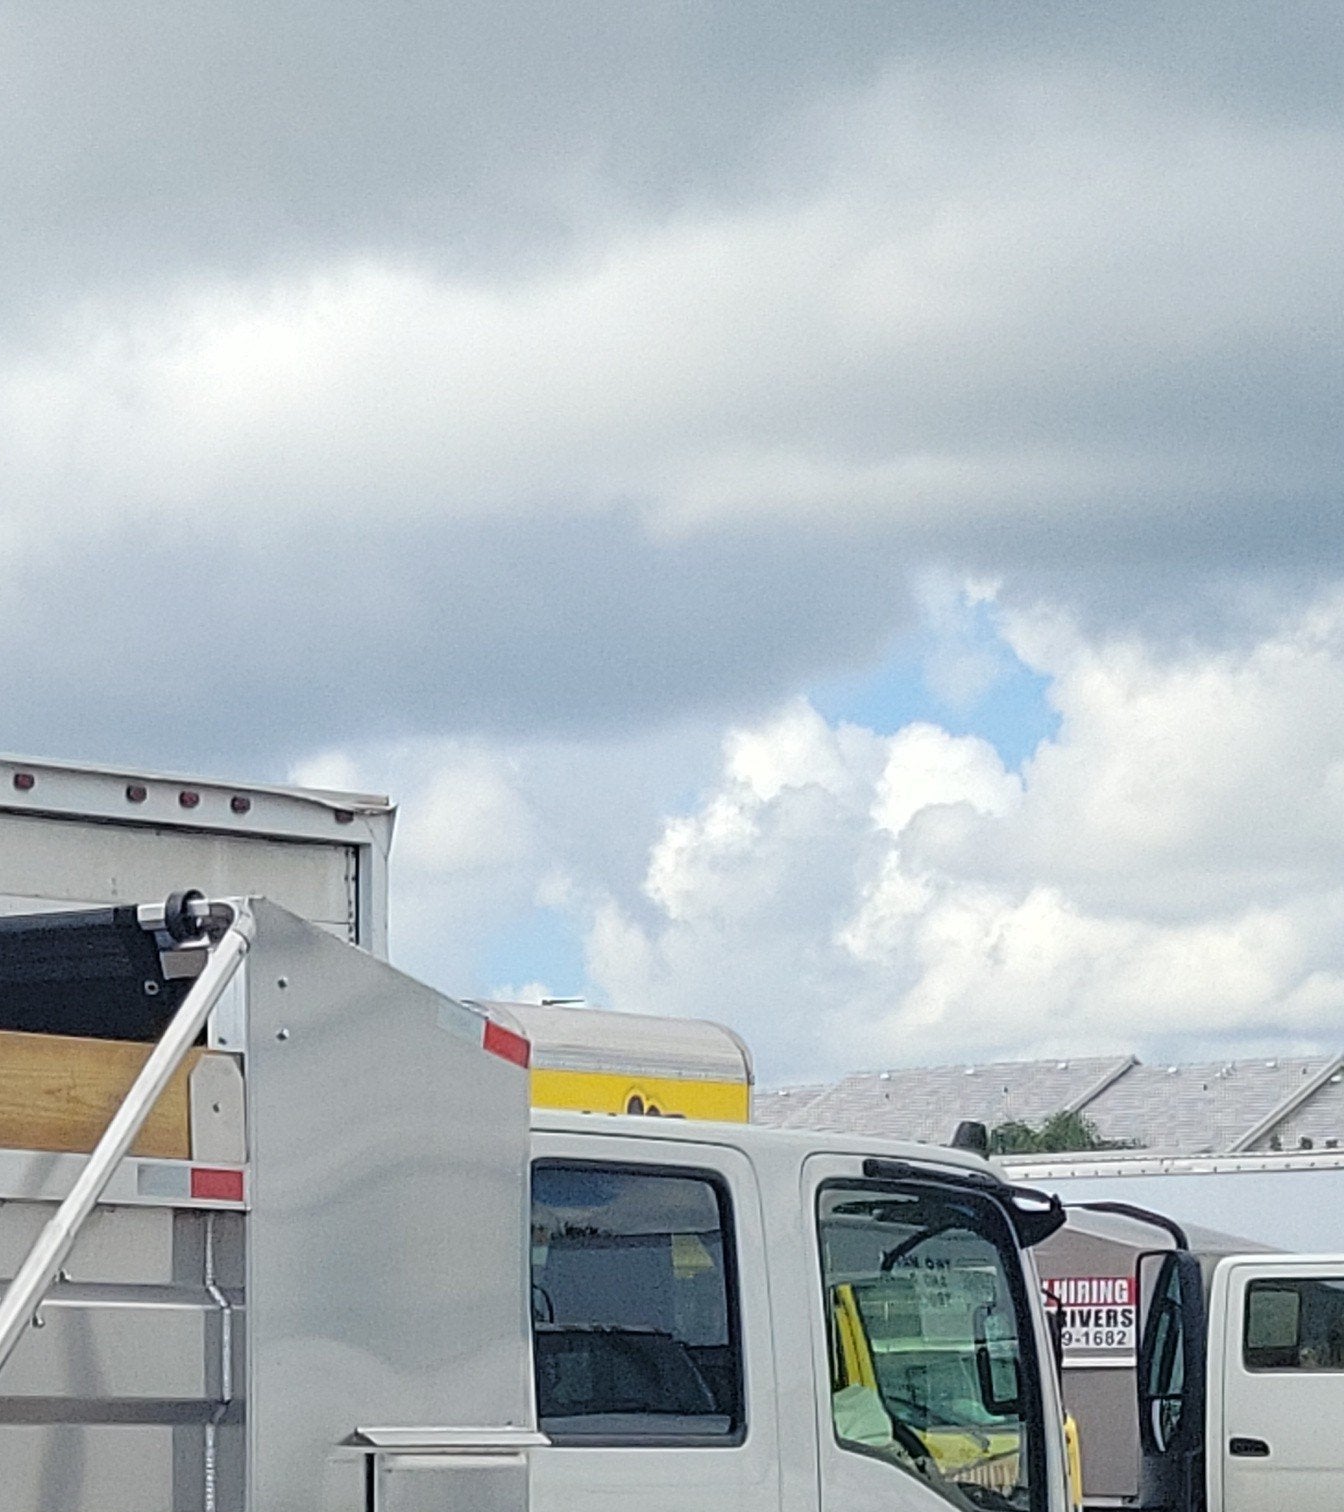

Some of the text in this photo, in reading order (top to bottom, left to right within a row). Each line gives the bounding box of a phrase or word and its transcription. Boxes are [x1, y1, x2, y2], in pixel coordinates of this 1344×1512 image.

[1053, 1278, 1129, 1304] HIRING
[1061, 1308, 1134, 1328] RIVERS
[1061, 1330, 1127, 1347] 9-1682
